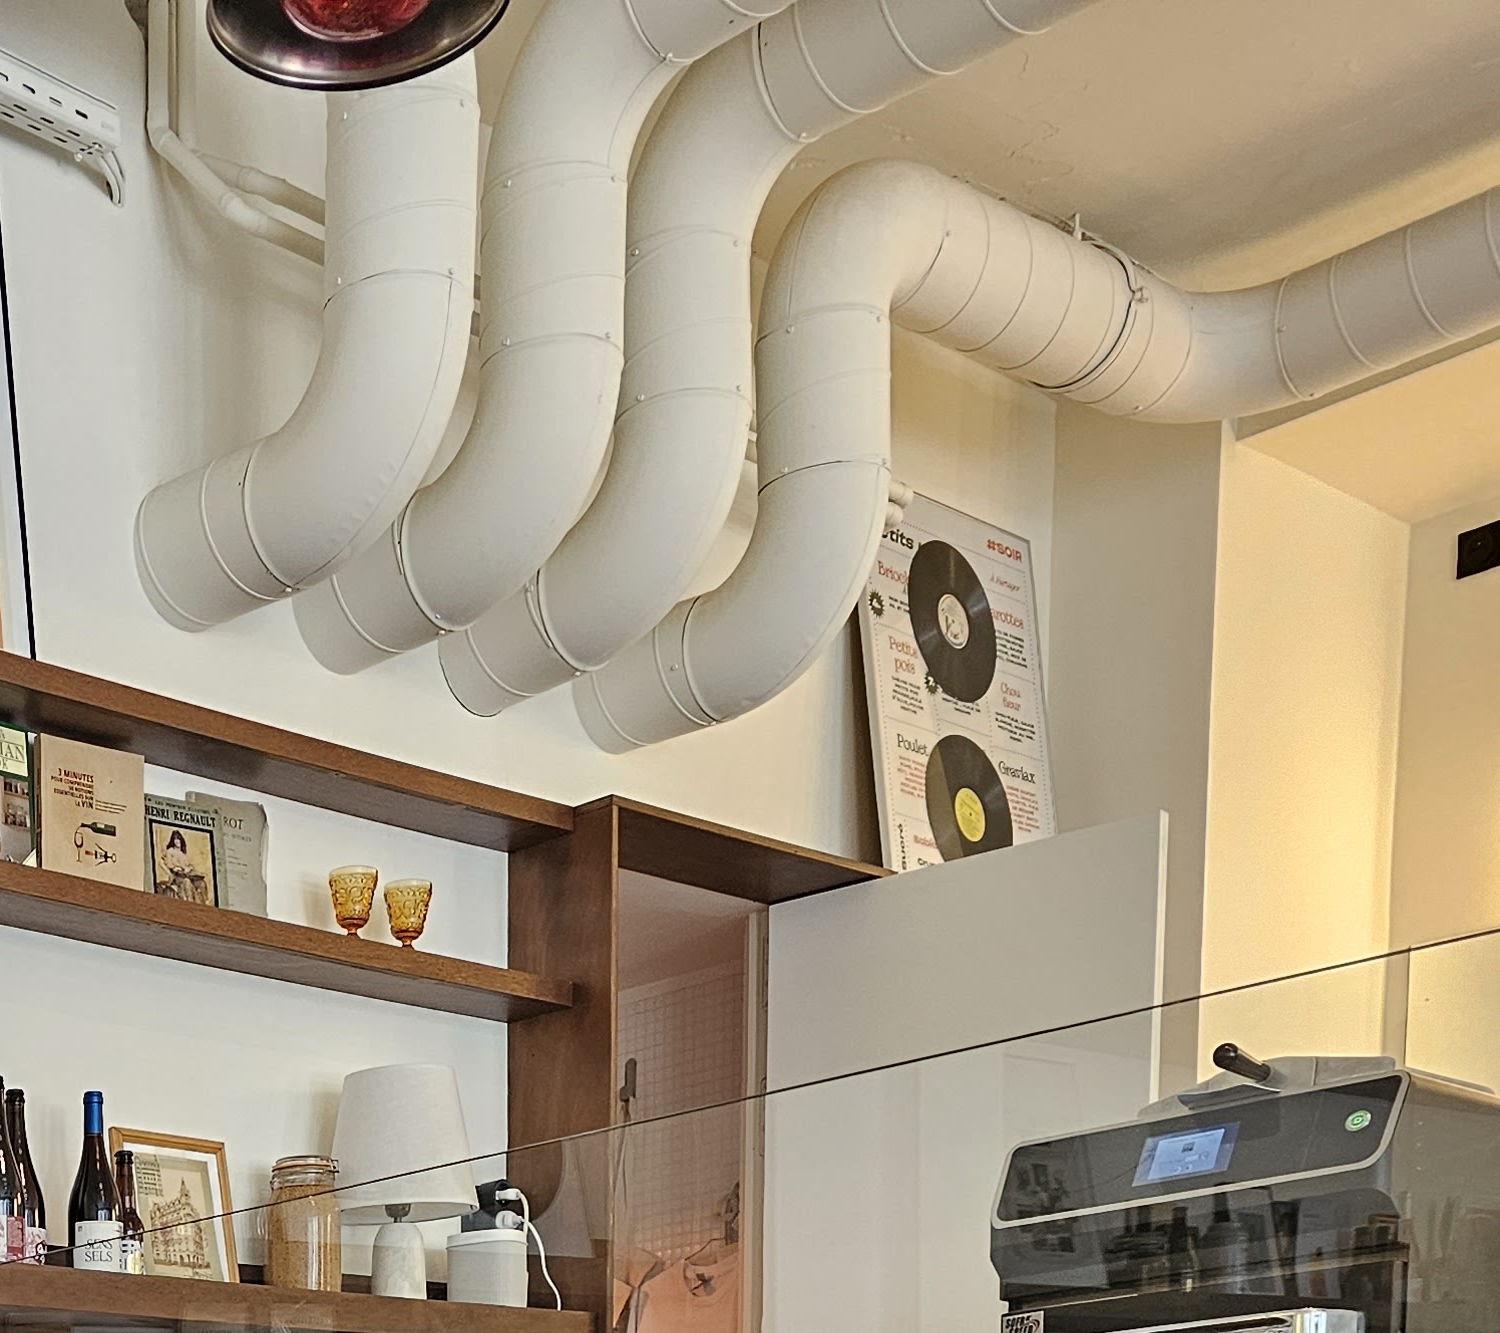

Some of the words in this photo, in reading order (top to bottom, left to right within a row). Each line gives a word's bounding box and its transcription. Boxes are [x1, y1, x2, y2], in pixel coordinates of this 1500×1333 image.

[987, 539, 1022, 562] #SOIR
[64, 770, 94, 783] MINUTES
[81, 800, 94, 809] VIN
[145, 804, 170, 820] HENRI
[174, 810, 216, 827] REGNAULT
[223, 816, 244, 830] ROT
[84, 1252, 112, 1262] SELS
